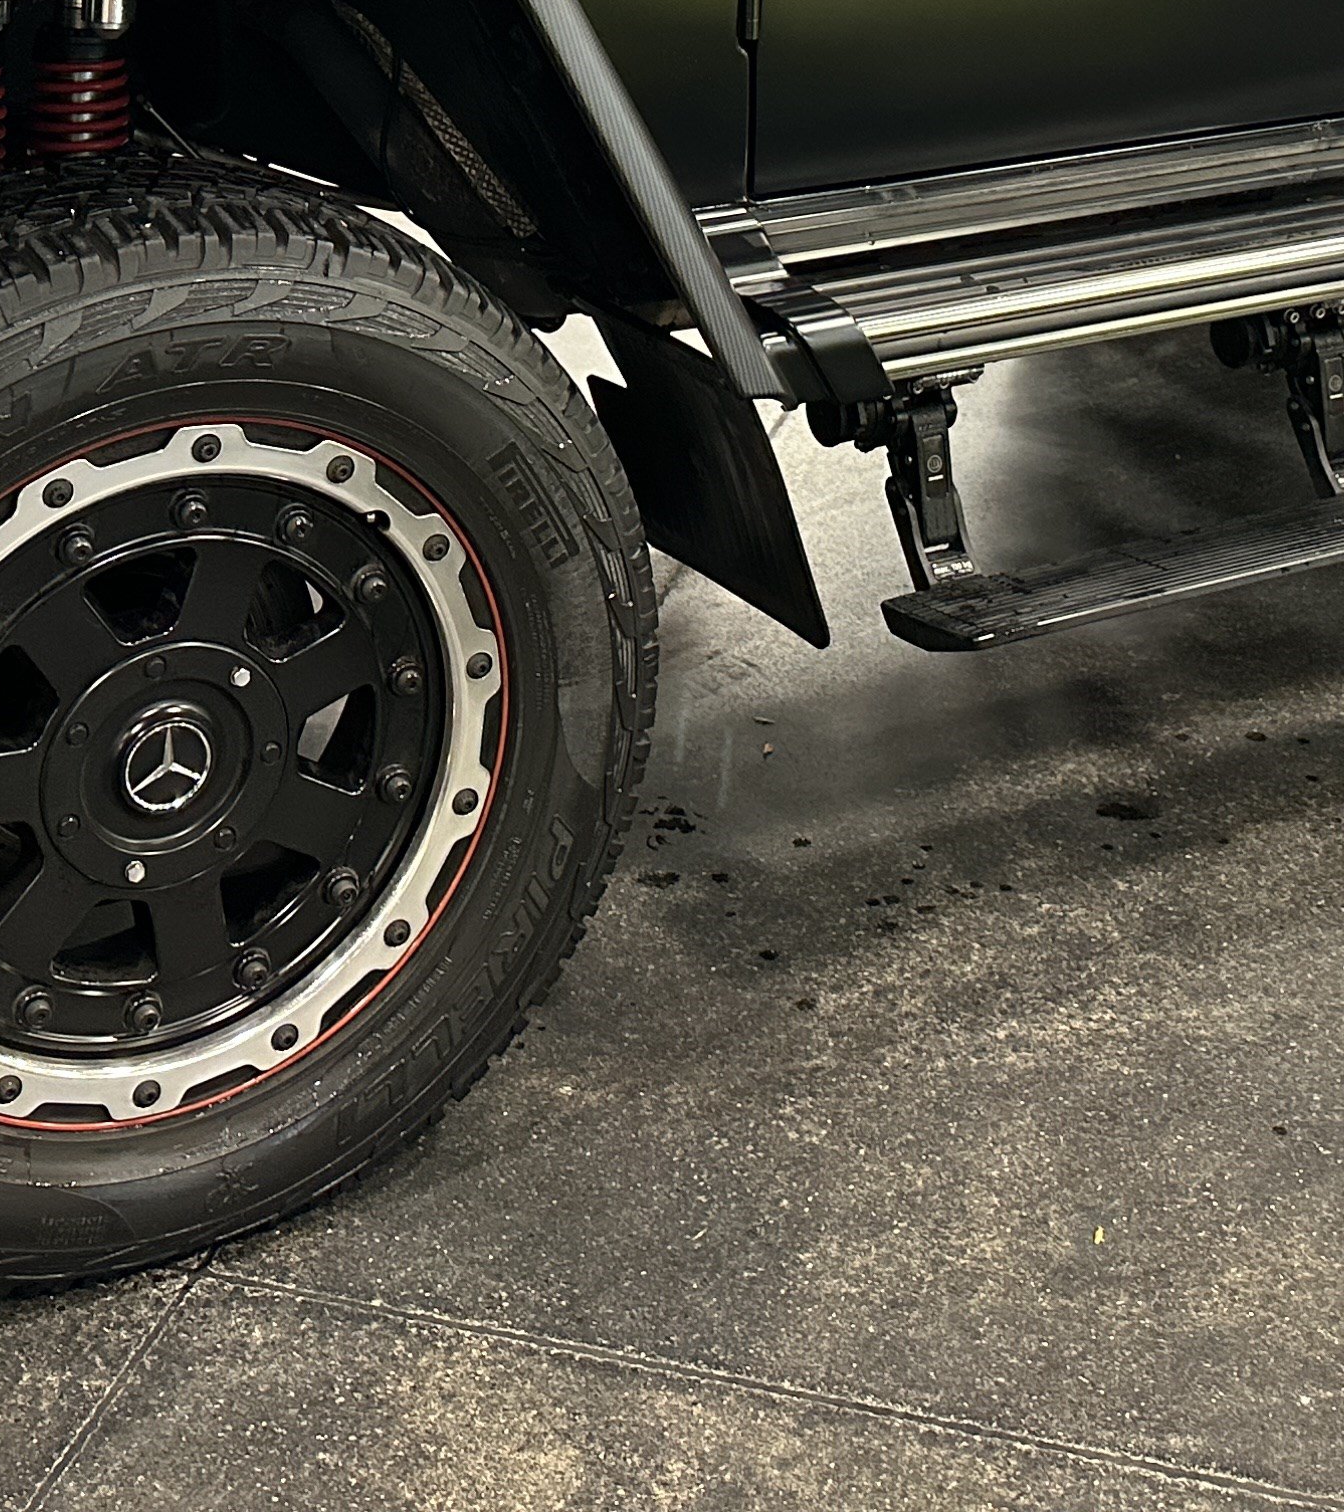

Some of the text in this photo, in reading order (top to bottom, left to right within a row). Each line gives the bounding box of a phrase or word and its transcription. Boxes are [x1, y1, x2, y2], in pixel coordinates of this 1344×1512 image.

[96, 333, 294, 394] ATR
[485, 438, 579, 569] PIRELLI
[336, 813, 576, 1149] PIRELLI
